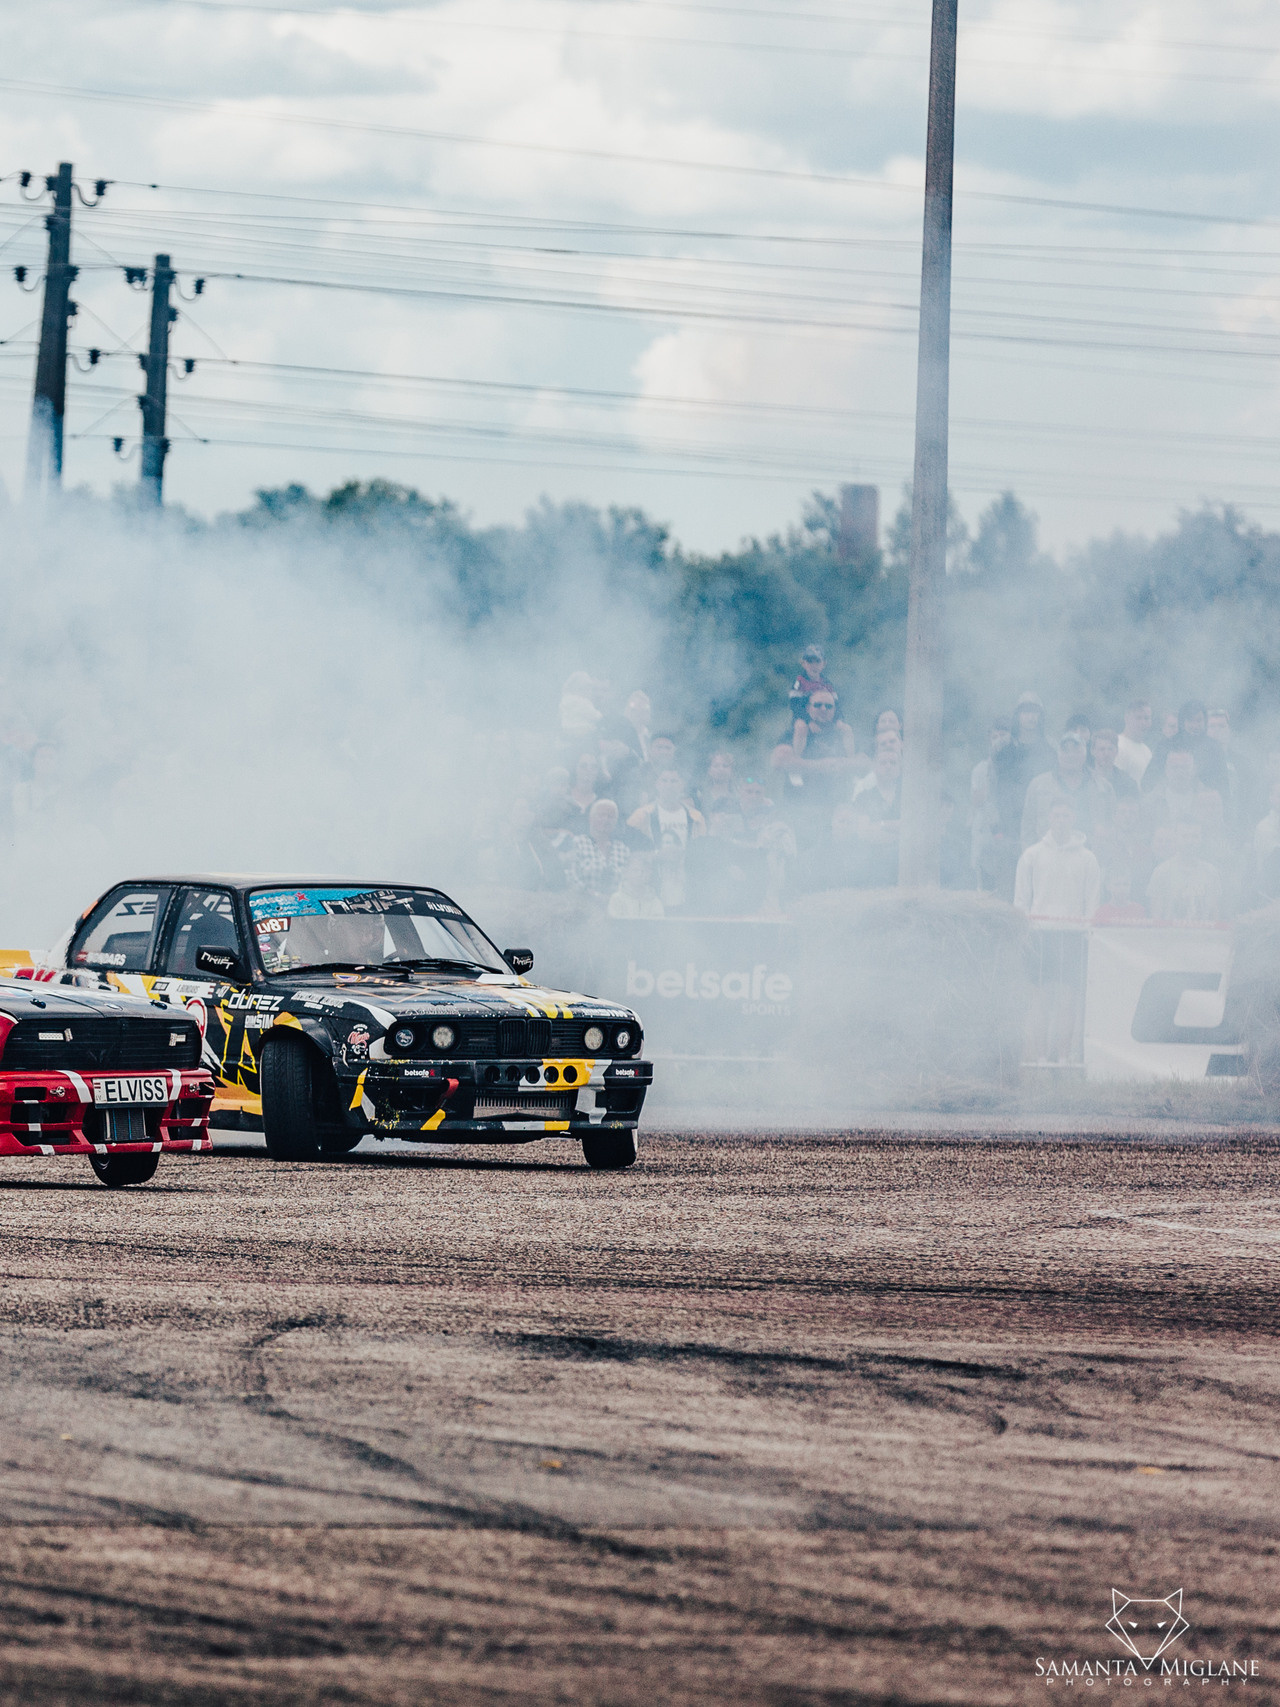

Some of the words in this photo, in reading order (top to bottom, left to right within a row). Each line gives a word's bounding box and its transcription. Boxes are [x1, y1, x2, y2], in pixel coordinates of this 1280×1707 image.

[256, 918, 288, 934] LV87
[625, 960, 794, 1002] betsafe
[741, 1002, 792, 1017] SPORTS
[104, 1078, 165, 1102] ELVISS
